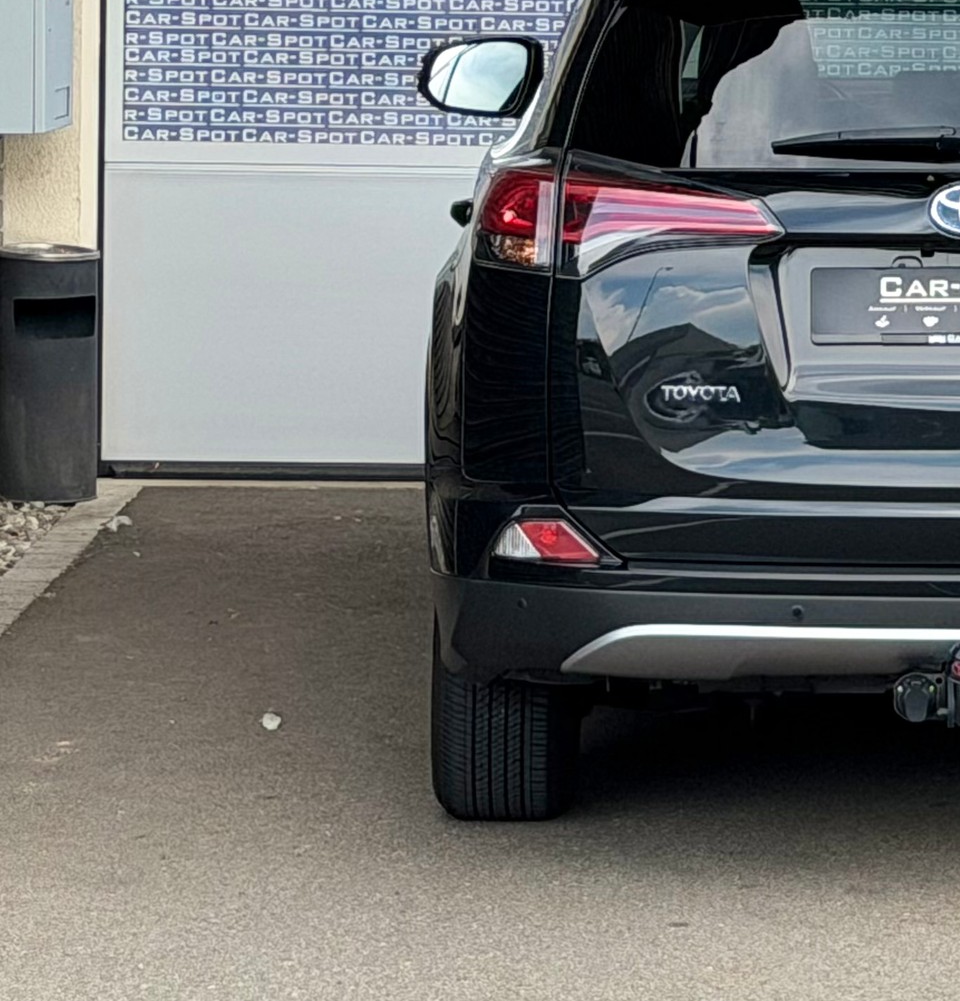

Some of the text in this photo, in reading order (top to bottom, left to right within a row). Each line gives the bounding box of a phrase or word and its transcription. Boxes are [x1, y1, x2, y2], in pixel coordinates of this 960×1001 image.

[127, 12, 476, 29] CAR-SPOT CAR-SPOT CAR-SPOT
[212, 33, 326, 47] CAR-SPOT
[126, 49, 358, 64] CAR-SPOT CAR-SPOT
[211, 70, 326, 84] CAR-SPOT
[125, 89, 357, 104] CAR-SPOT CAR-SPOT
[210, 110, 325, 123] CAR-SPOT
[328, 111, 442, 125] CAR-SPOT
[125, 129, 474, 144] CAR-SPOT CAR-SPOT CAR-SPOT
[660, 385, 741, 403] TOYOTA
